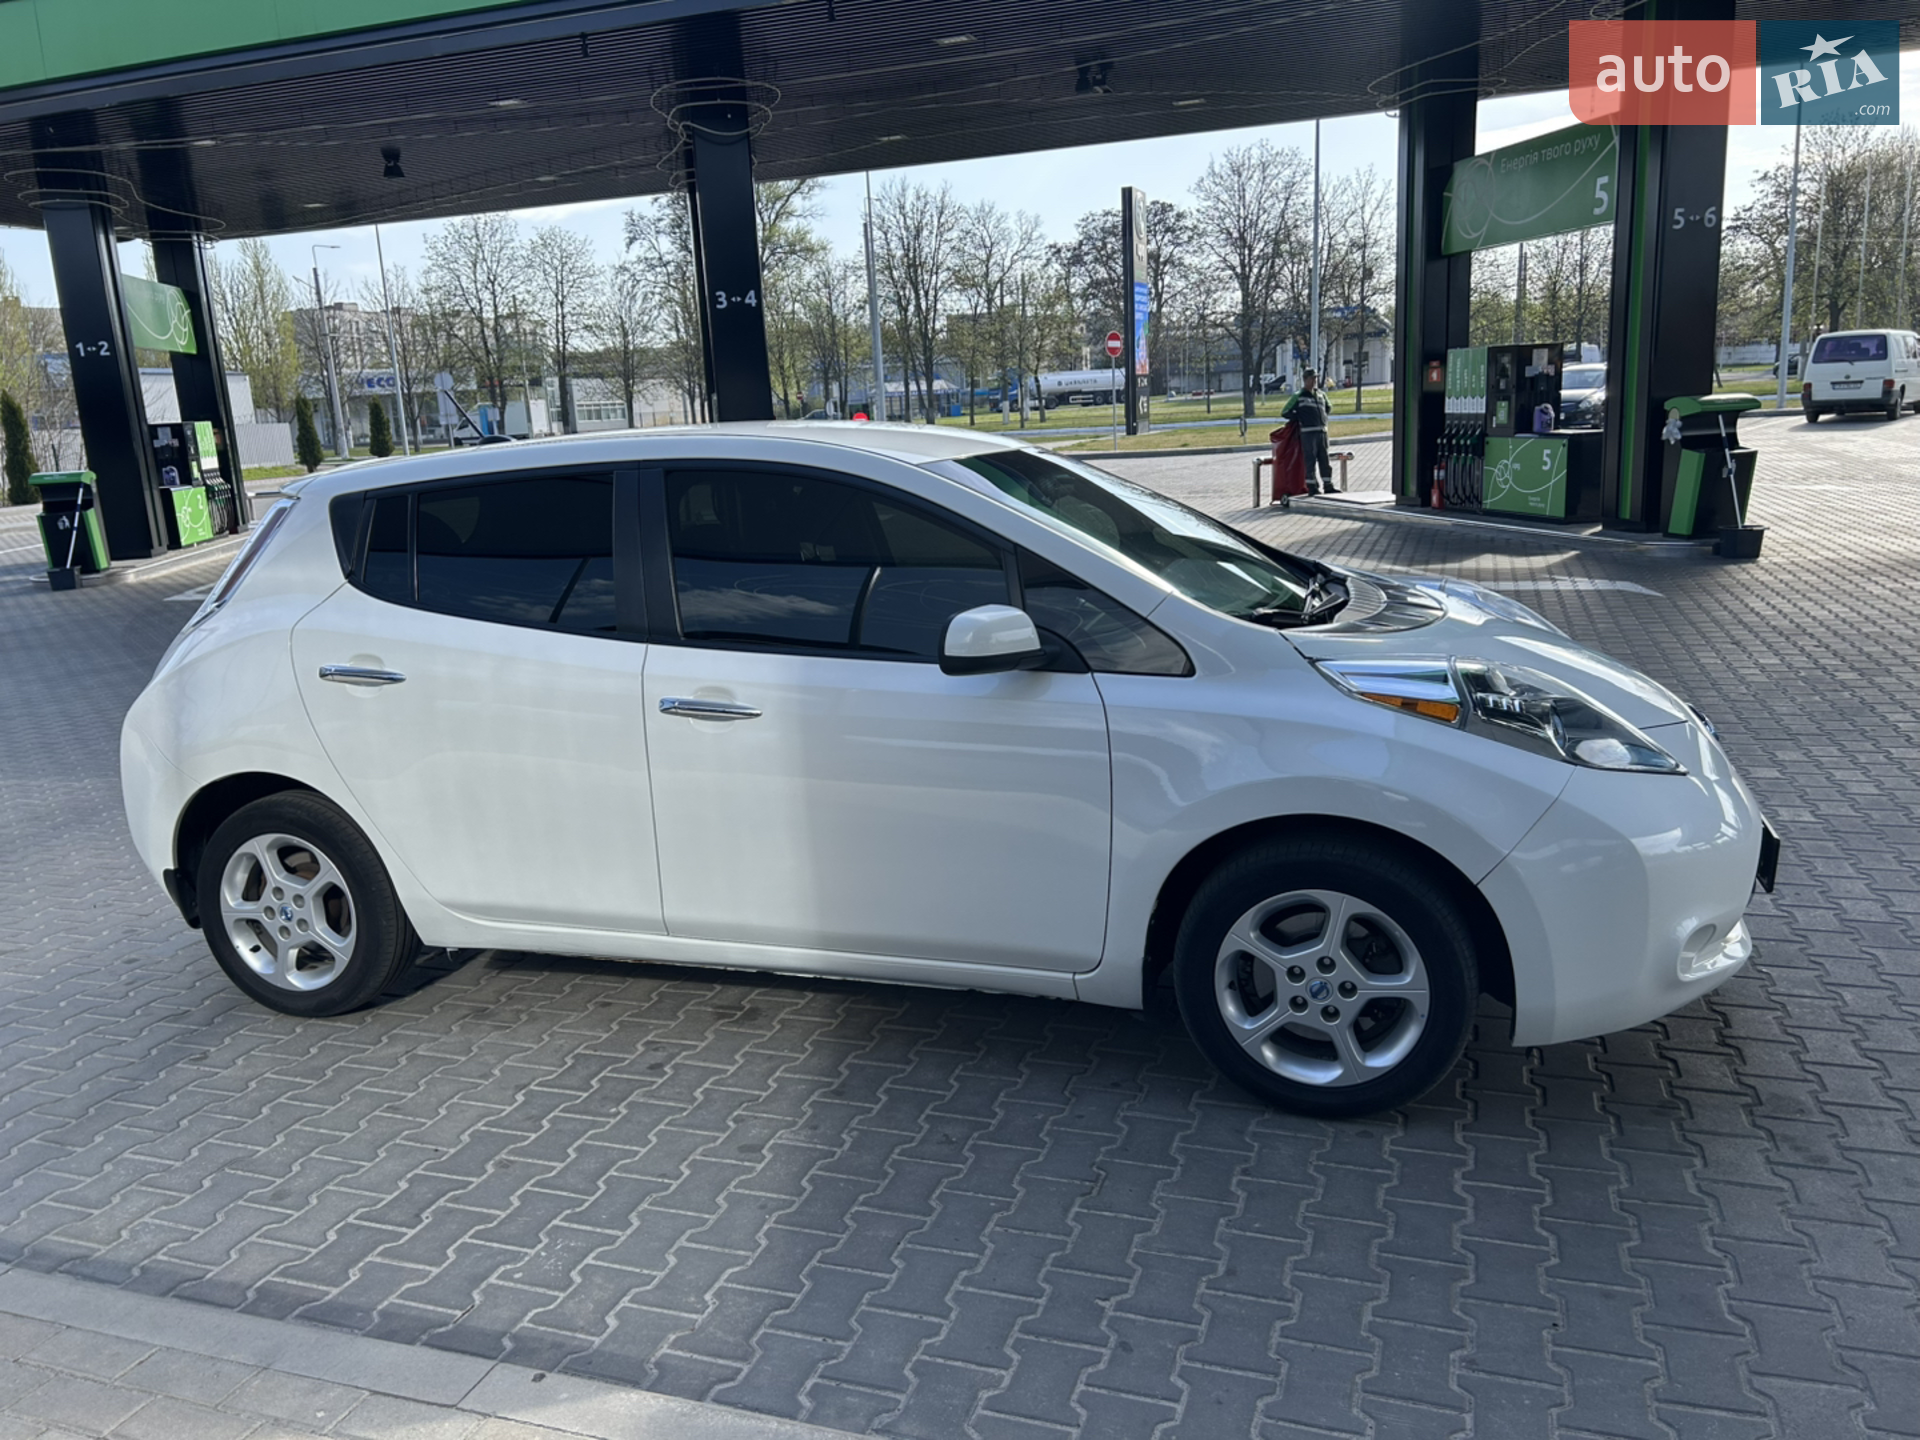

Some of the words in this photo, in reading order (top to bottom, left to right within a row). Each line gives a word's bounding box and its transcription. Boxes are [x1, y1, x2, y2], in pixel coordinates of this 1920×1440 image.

[1500, 149, 1539, 173] Енергія
[1541, 142, 1571, 162] твого
[1574, 133, 1601, 156] руху
[1592, 175, 1609, 216] 5
[1541, 448, 1552, 471] 5
